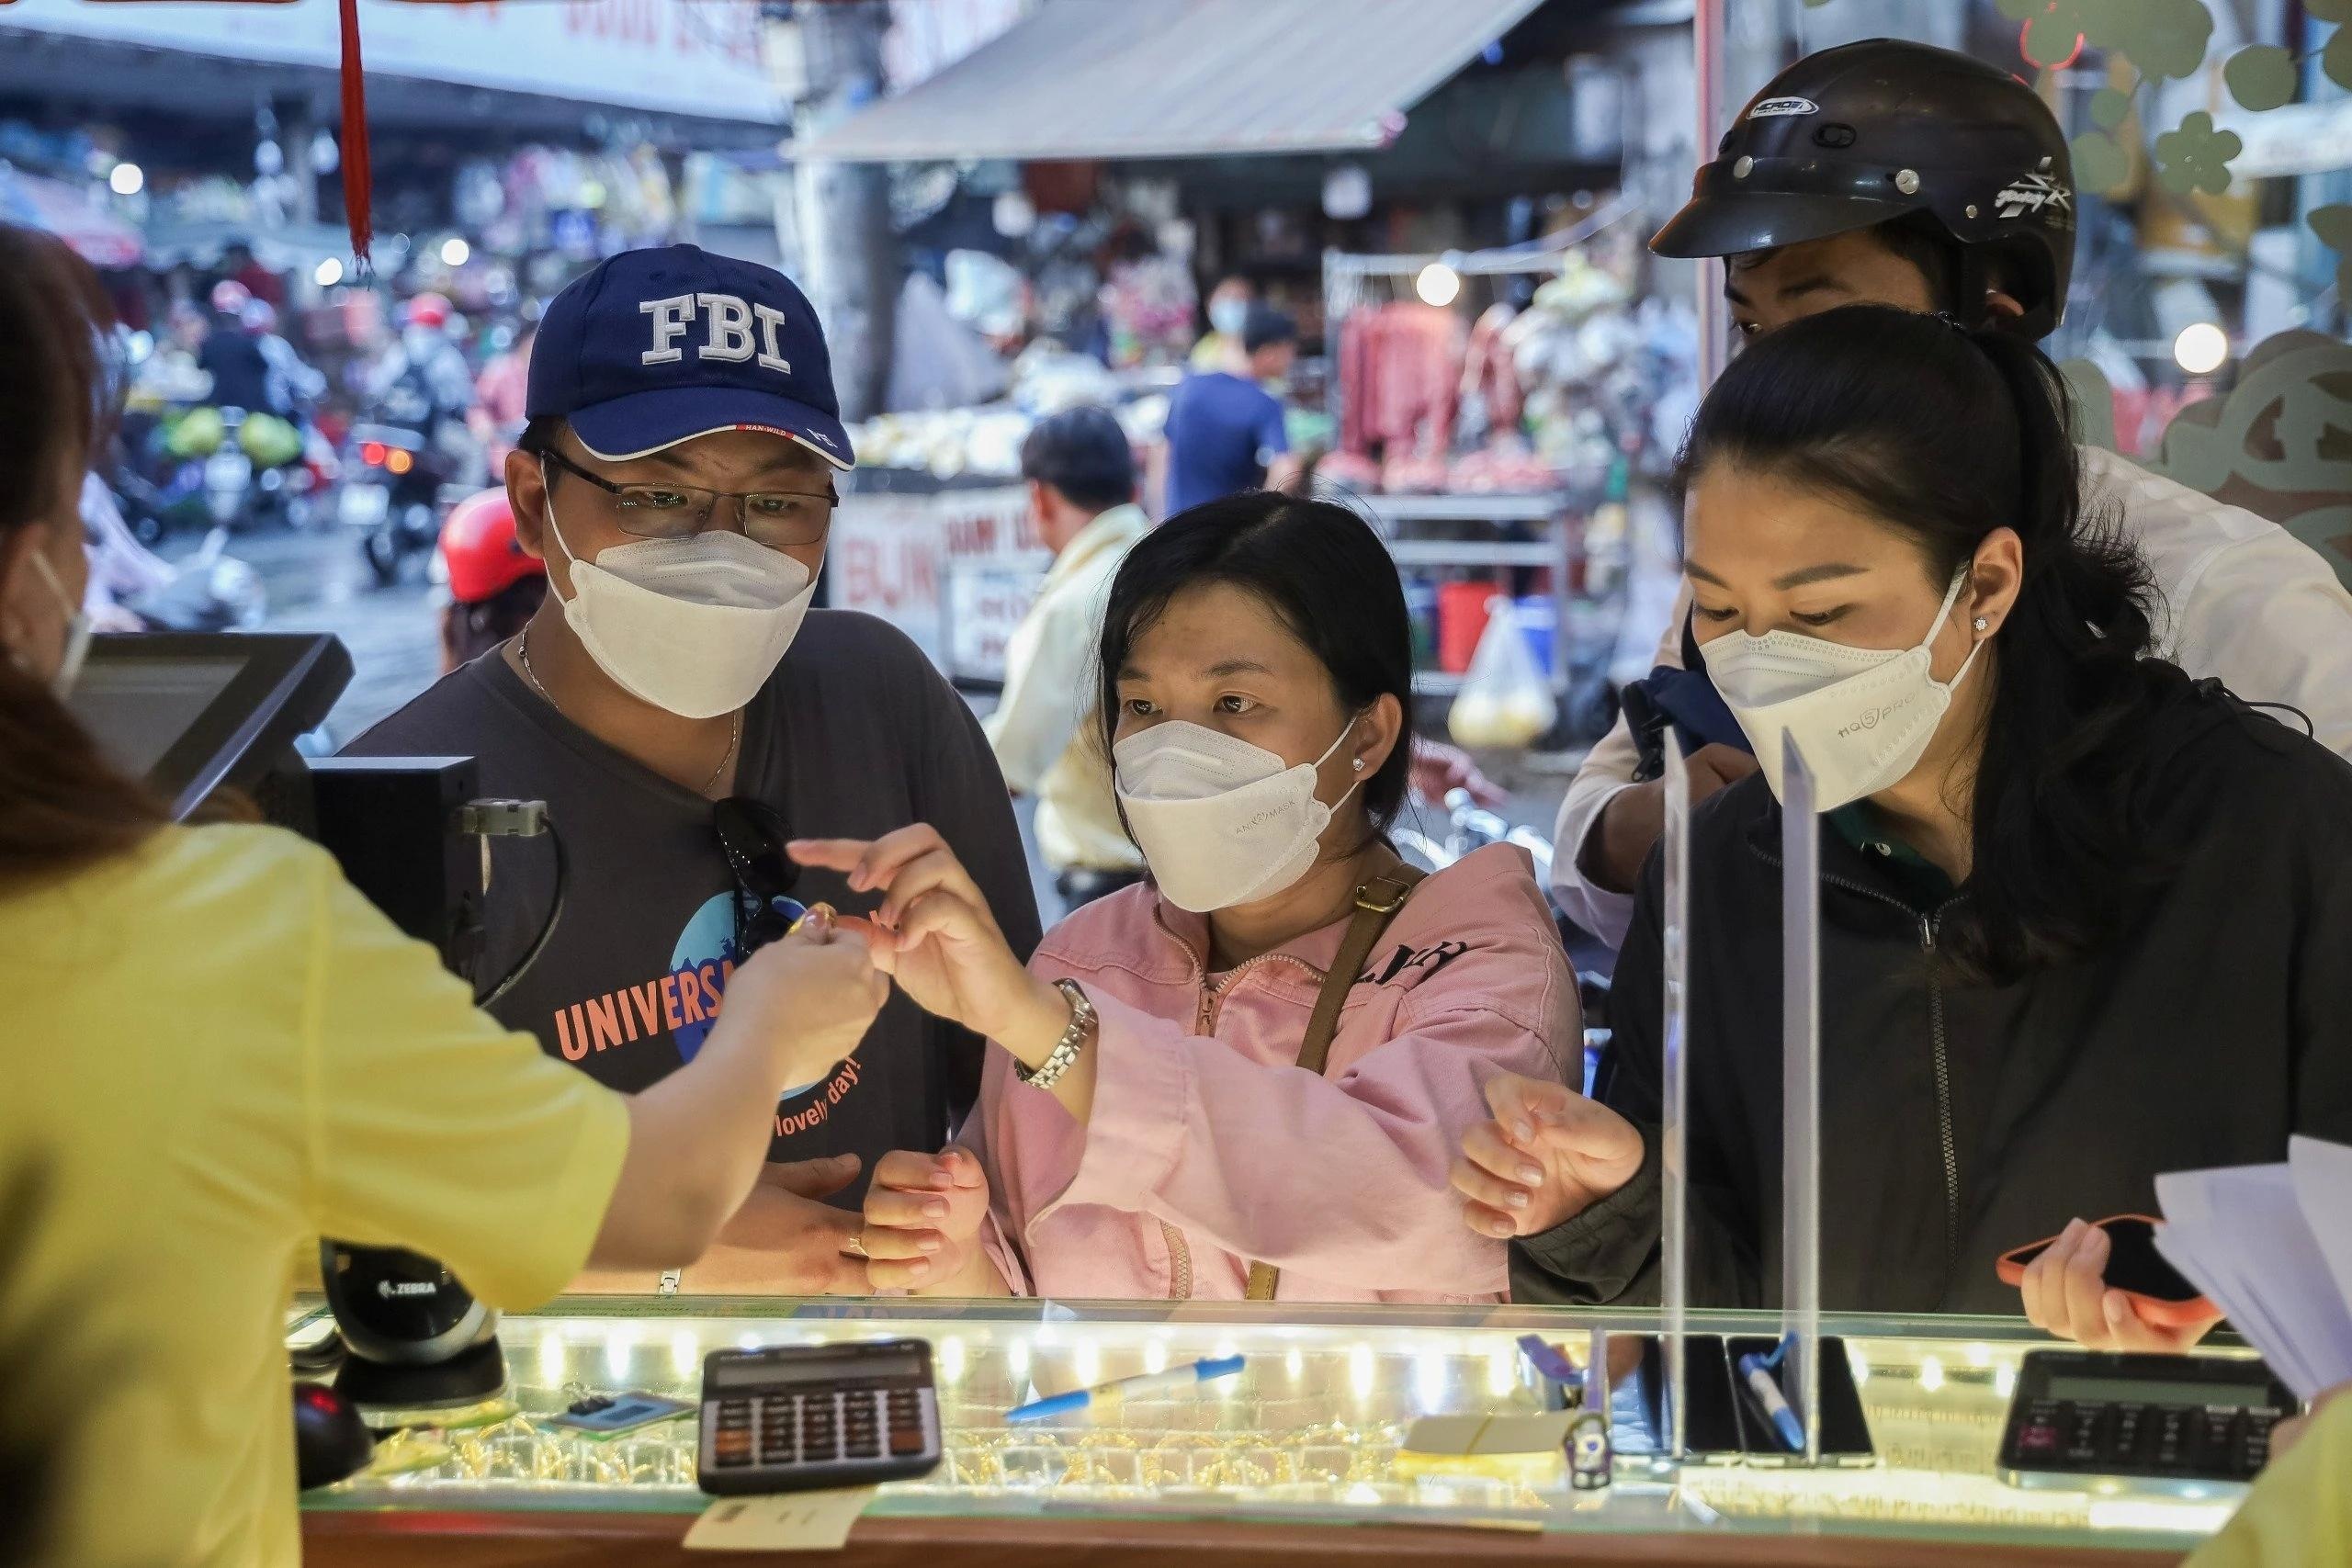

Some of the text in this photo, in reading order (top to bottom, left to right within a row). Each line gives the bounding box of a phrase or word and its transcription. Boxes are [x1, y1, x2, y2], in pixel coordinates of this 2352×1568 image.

[639, 292, 791, 375] FBI
[828, 1055, 862, 1104] day!
[397, 1281, 436, 1294] ZEBRA
